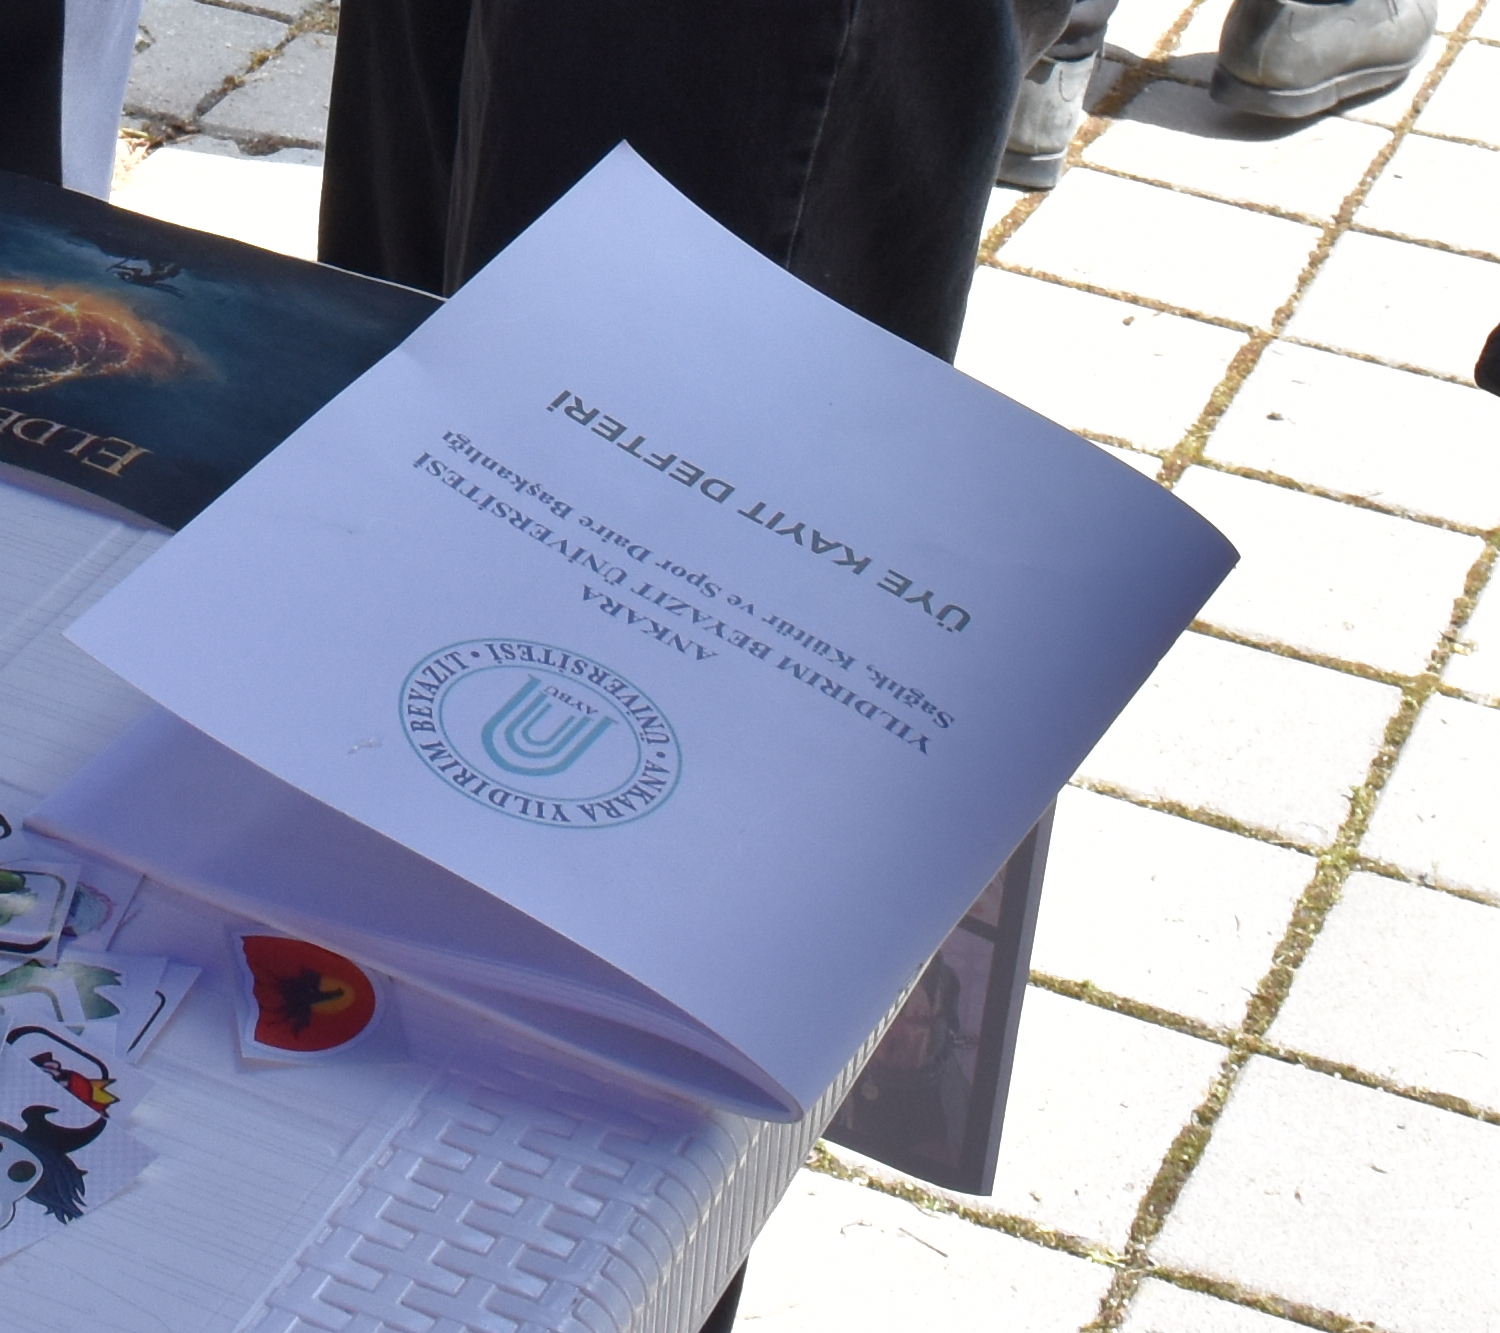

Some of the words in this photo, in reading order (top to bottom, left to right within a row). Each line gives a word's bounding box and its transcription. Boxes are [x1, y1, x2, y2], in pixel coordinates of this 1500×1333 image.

[442, 429, 575, 521] Başkanlığı
[546, 389, 737, 504] DEFTERİ
[411, 450, 629, 588] ÜNİVERSİTESİ
[579, 513, 651, 563] Daire
[738, 500, 873, 576] KAYIT
[659, 556, 724, 601] Spor
[727, 593, 757, 617] ve
[877, 567, 972, 634] ÜYE
[580, 583, 719, 662] ANKARA
[630, 577, 773, 660] BEYAZIT
[763, 611, 860, 670] Kültür
[407, 650, 471, 734] BEYAZIT
[485, 642, 671, 746] ÜNİVERSİTESİ
[777, 652, 935, 756] YILDIRIM
[865, 662, 956, 731] Sağlık,
[420, 740, 572, 823] YILDIRIM
[577, 758, 671, 823] ANKARA
